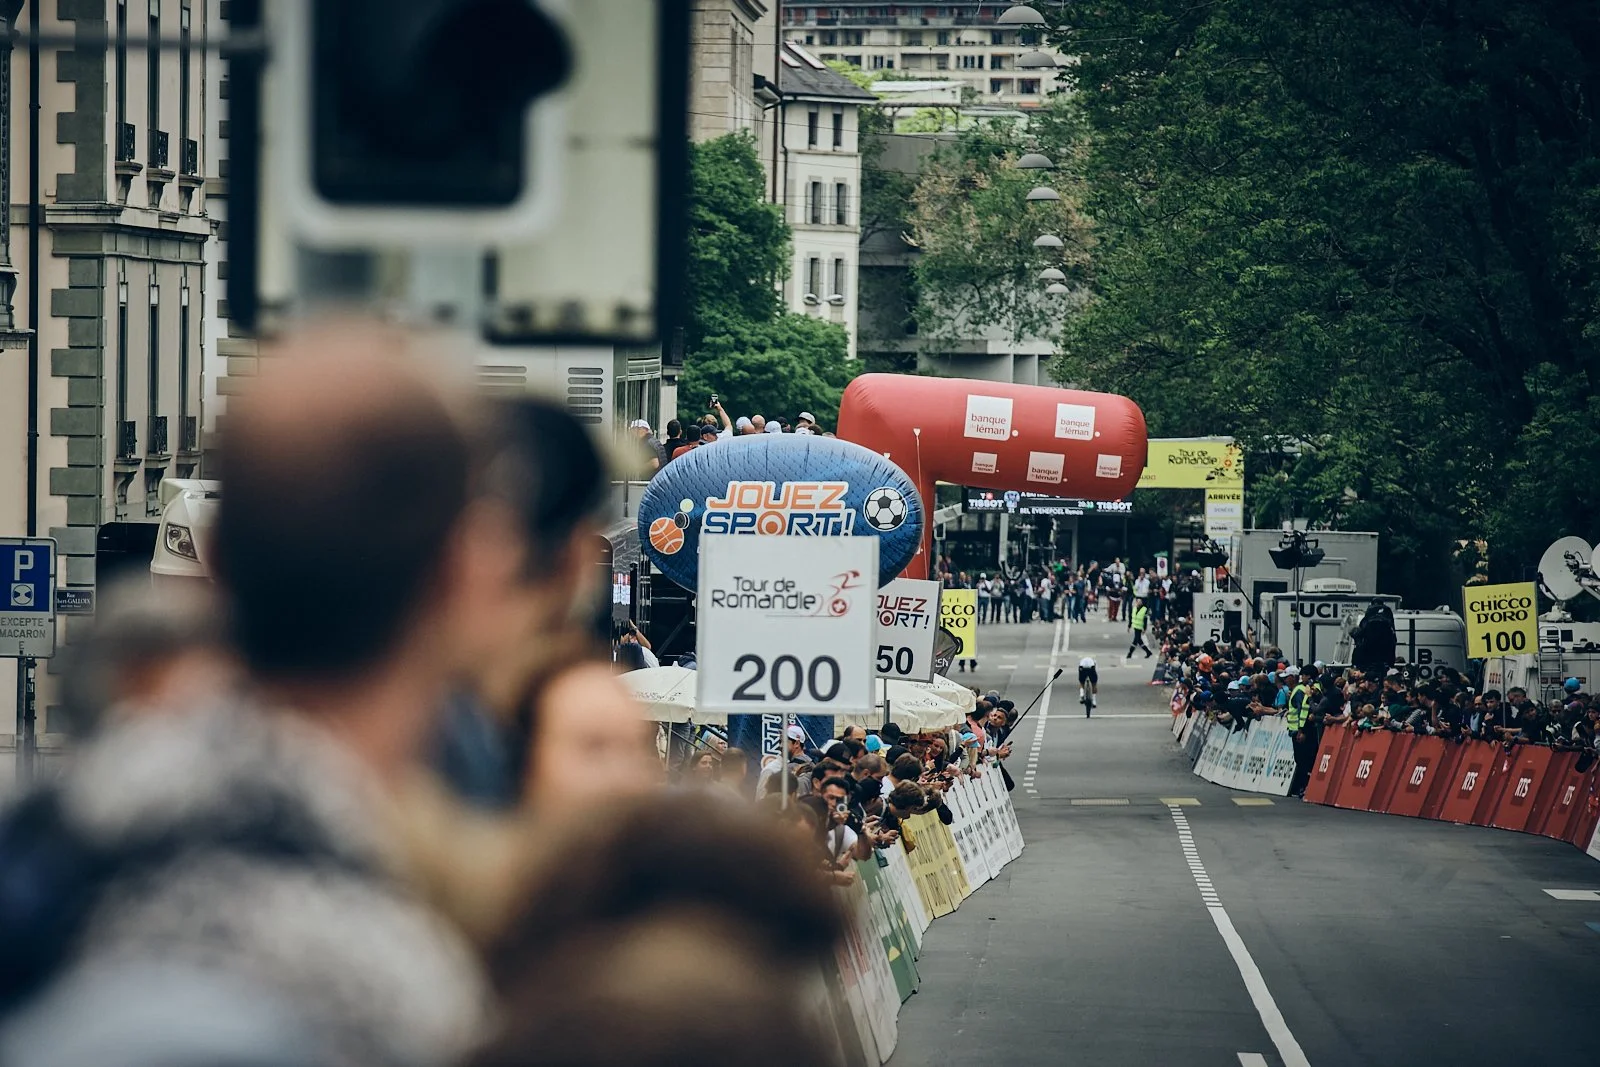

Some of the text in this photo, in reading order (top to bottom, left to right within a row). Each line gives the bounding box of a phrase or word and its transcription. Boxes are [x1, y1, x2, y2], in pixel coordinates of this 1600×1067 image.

[971, 413, 1007, 426] banque
[1060, 418, 1090, 428] banque
[976, 424, 1006, 436] léman
[1065, 426, 1090, 437] léman
[1168, 454, 1218, 465] Romandie
[1179, 449, 1209, 457] Tour de
[1031, 466, 1059, 477] banque
[1035, 473, 1058, 482] léman
[708, 483, 847, 511] JOUEZ
[968, 498, 1004, 508] TISSOT
[1096, 501, 1133, 510] TISSOT
[703, 510, 857, 537] SPORT!
[14, 550, 34, 581] P
[733, 576, 796, 593] Tour de
[711, 588, 816, 610] Romandie
[877, 595, 928, 613] OUEZ
[1469, 597, 1532, 613] CHICCO
[940, 604, 976, 616] CCO
[1299, 602, 1338, 619] UCI
[1476, 609, 1529, 624] D'ORO
[1, 617, 44, 627] EXCEPTE
[877, 609, 931, 630] ORT!
[0, 629, 46, 639] MACARON
[1481, 630, 1526, 653] 100
[876, 645, 914, 675] 50
[731, 653, 841, 702] 200
[1355, 759, 1374, 779] RTS
[1409, 765, 1427, 786] RTS
[1461, 771, 1479, 791] RTS
[1514, 777, 1532, 798] RTS
